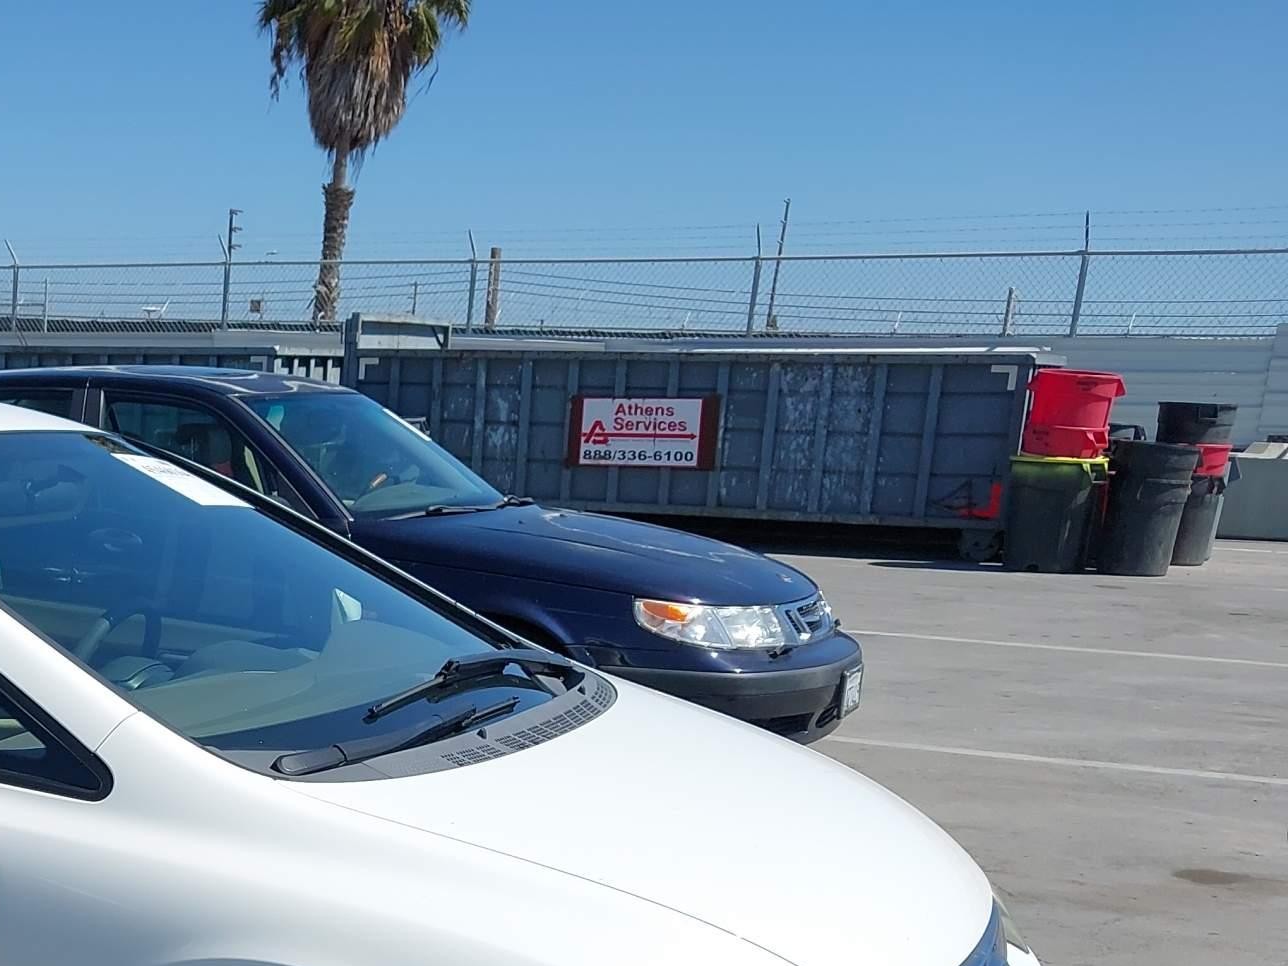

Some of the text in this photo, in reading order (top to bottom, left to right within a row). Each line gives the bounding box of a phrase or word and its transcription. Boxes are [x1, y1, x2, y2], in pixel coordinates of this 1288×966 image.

[615, 403, 674, 416] Athens
[613, 417, 687, 431] Services
[583, 449, 694, 461] 888/336-6100
